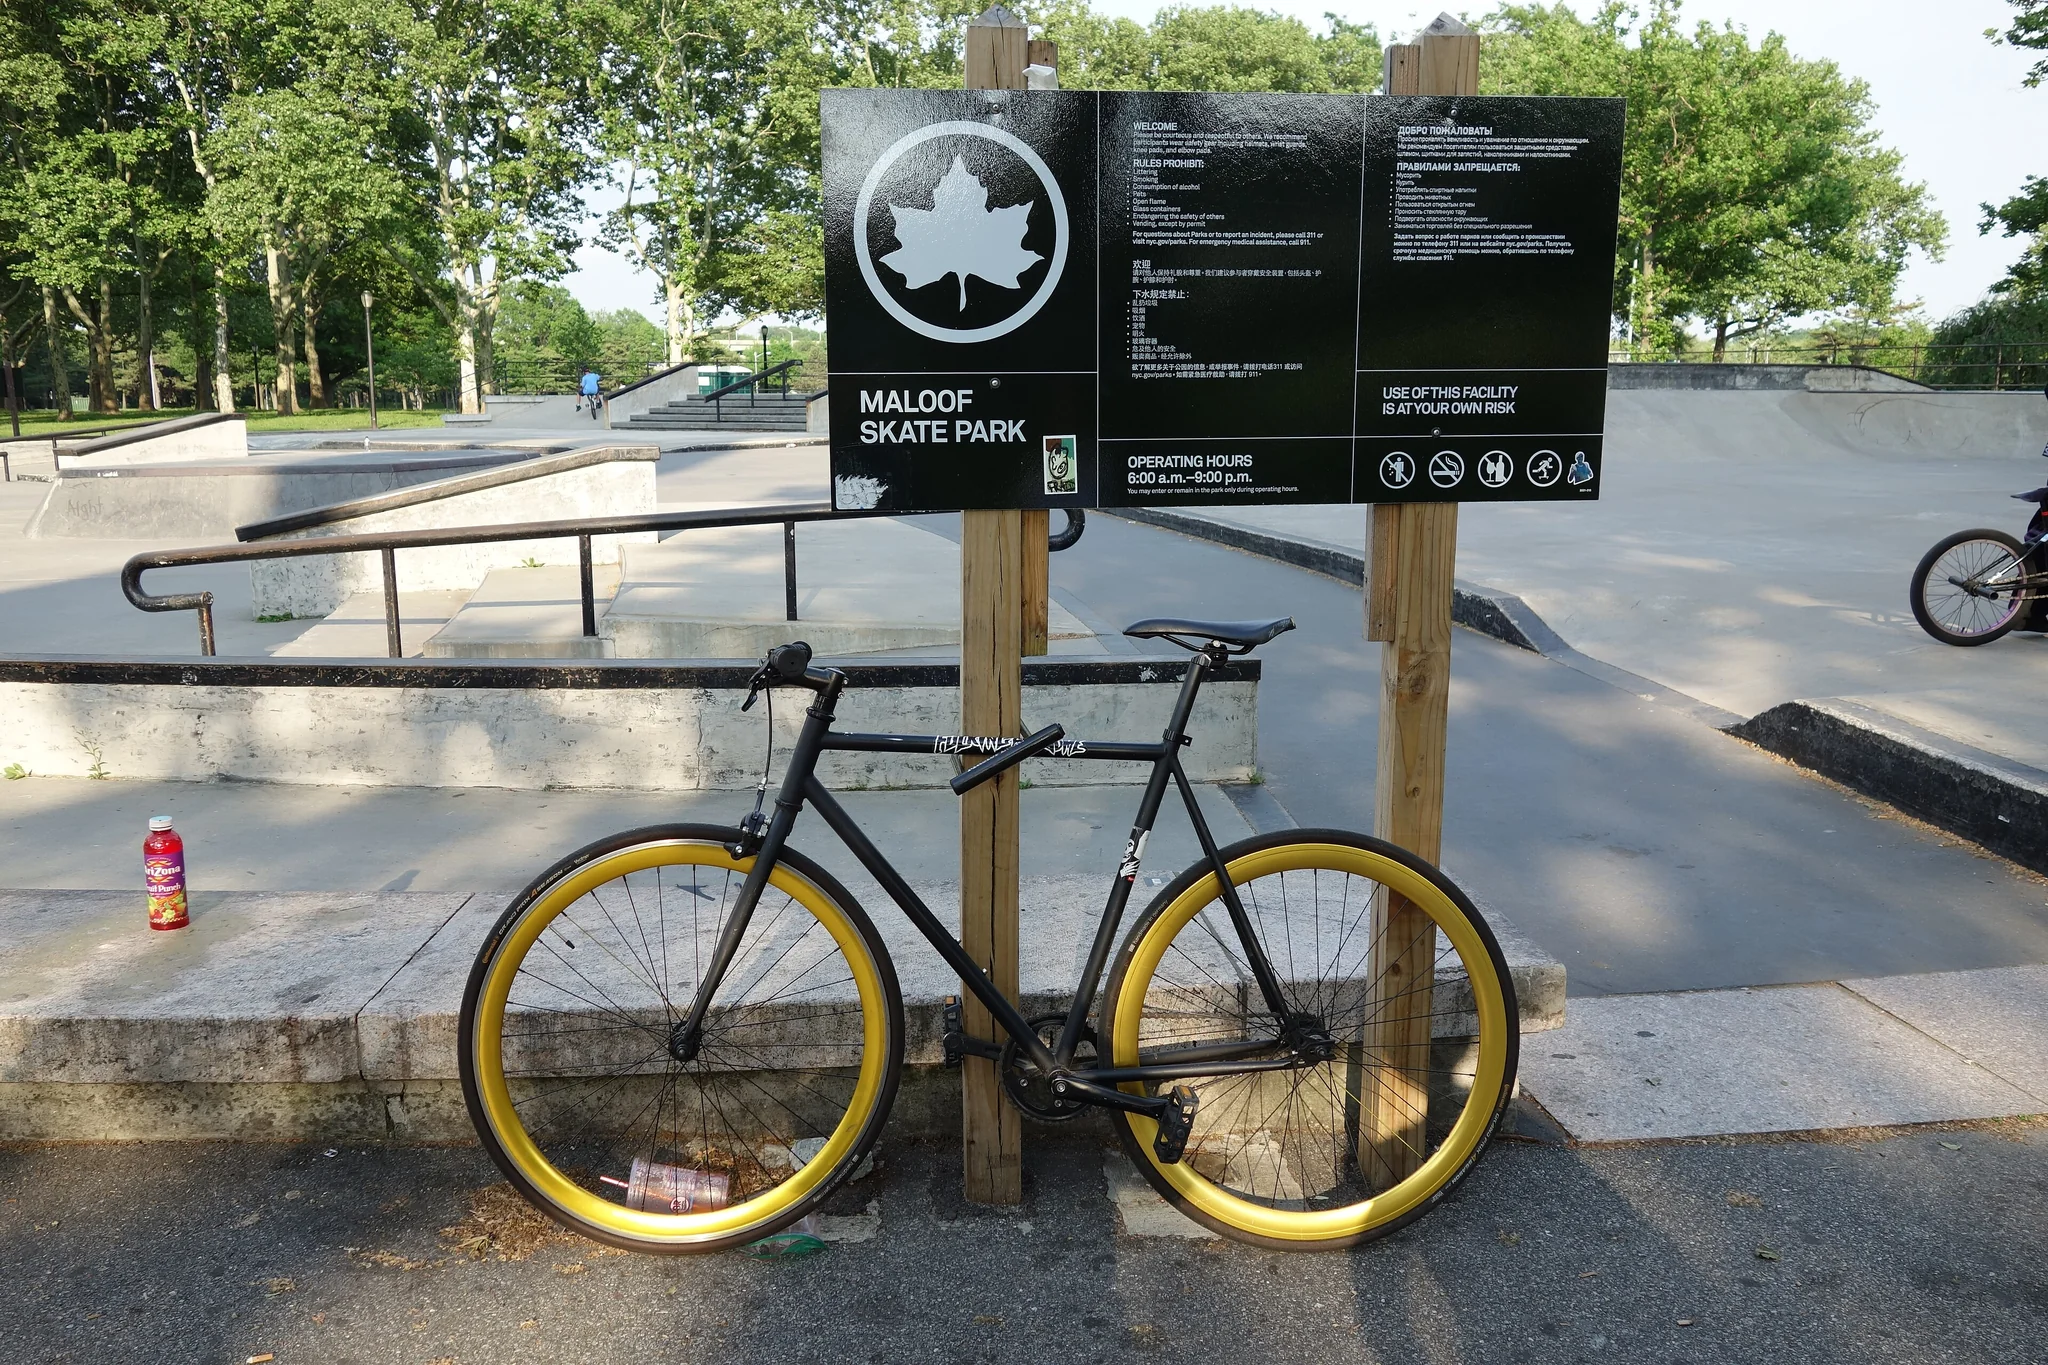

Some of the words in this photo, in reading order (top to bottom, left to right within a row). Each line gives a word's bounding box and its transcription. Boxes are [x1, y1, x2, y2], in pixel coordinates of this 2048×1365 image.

[1133, 122, 1178, 131] WELCOME
[1398, 126, 1428, 136] ДОБРО
[1430, 126, 1492, 136] ПОЖАЛОВАТЬ!
[1133, 140, 1169, 148] participants
[1133, 159, 1162, 168] RULES
[1163, 159, 1204, 168] PROHIBIT:
[1396, 162, 1452, 171] ПРАВИЛАМИ
[1453, 162, 1520, 173] ЗАПРЕЩАЕТСЯ:
[1132, 168, 1158, 176] Littering
[1132, 176, 1158, 184] Smoking
[1132, 184, 1172, 192] Consumption
[1132, 198, 1148, 206] Open
[1132, 213, 1169, 221] Endangering
[1144, 231, 1172, 239] questions
[1132, 259, 1151, 269] 欢迎
[1132, 306, 1146, 314] 吸烟
[1383, 386, 1410, 399] USE
[1411, 386, 1430, 399] OF
[1430, 386, 1460, 399] THIS
[1462, 386, 1518, 398] FACILITY
[860, 389, 973, 413] MALOOF
[1382, 402, 1395, 414] IS
[1396, 402, 1413, 414] AT
[1413, 402, 1450, 414] YOUR
[1451, 402, 1482, 414] OWN
[1484, 402, 1516, 414] RISK
[860, 420, 948, 444] SKATE
[955, 419, 1027, 443] PARK
[1127, 455, 1204, 468] OPERATING
[1206, 454, 1252, 468] HOURS
[1127, 472, 1156, 484] 6:00
[1225, 472, 1252, 486] p.m.
[1255, 486, 1281, 494] operating
[158, 882, 181, 893] Punch
[498, 911, 517, 936] GRAND
[516, 896, 531, 913] PRIX
